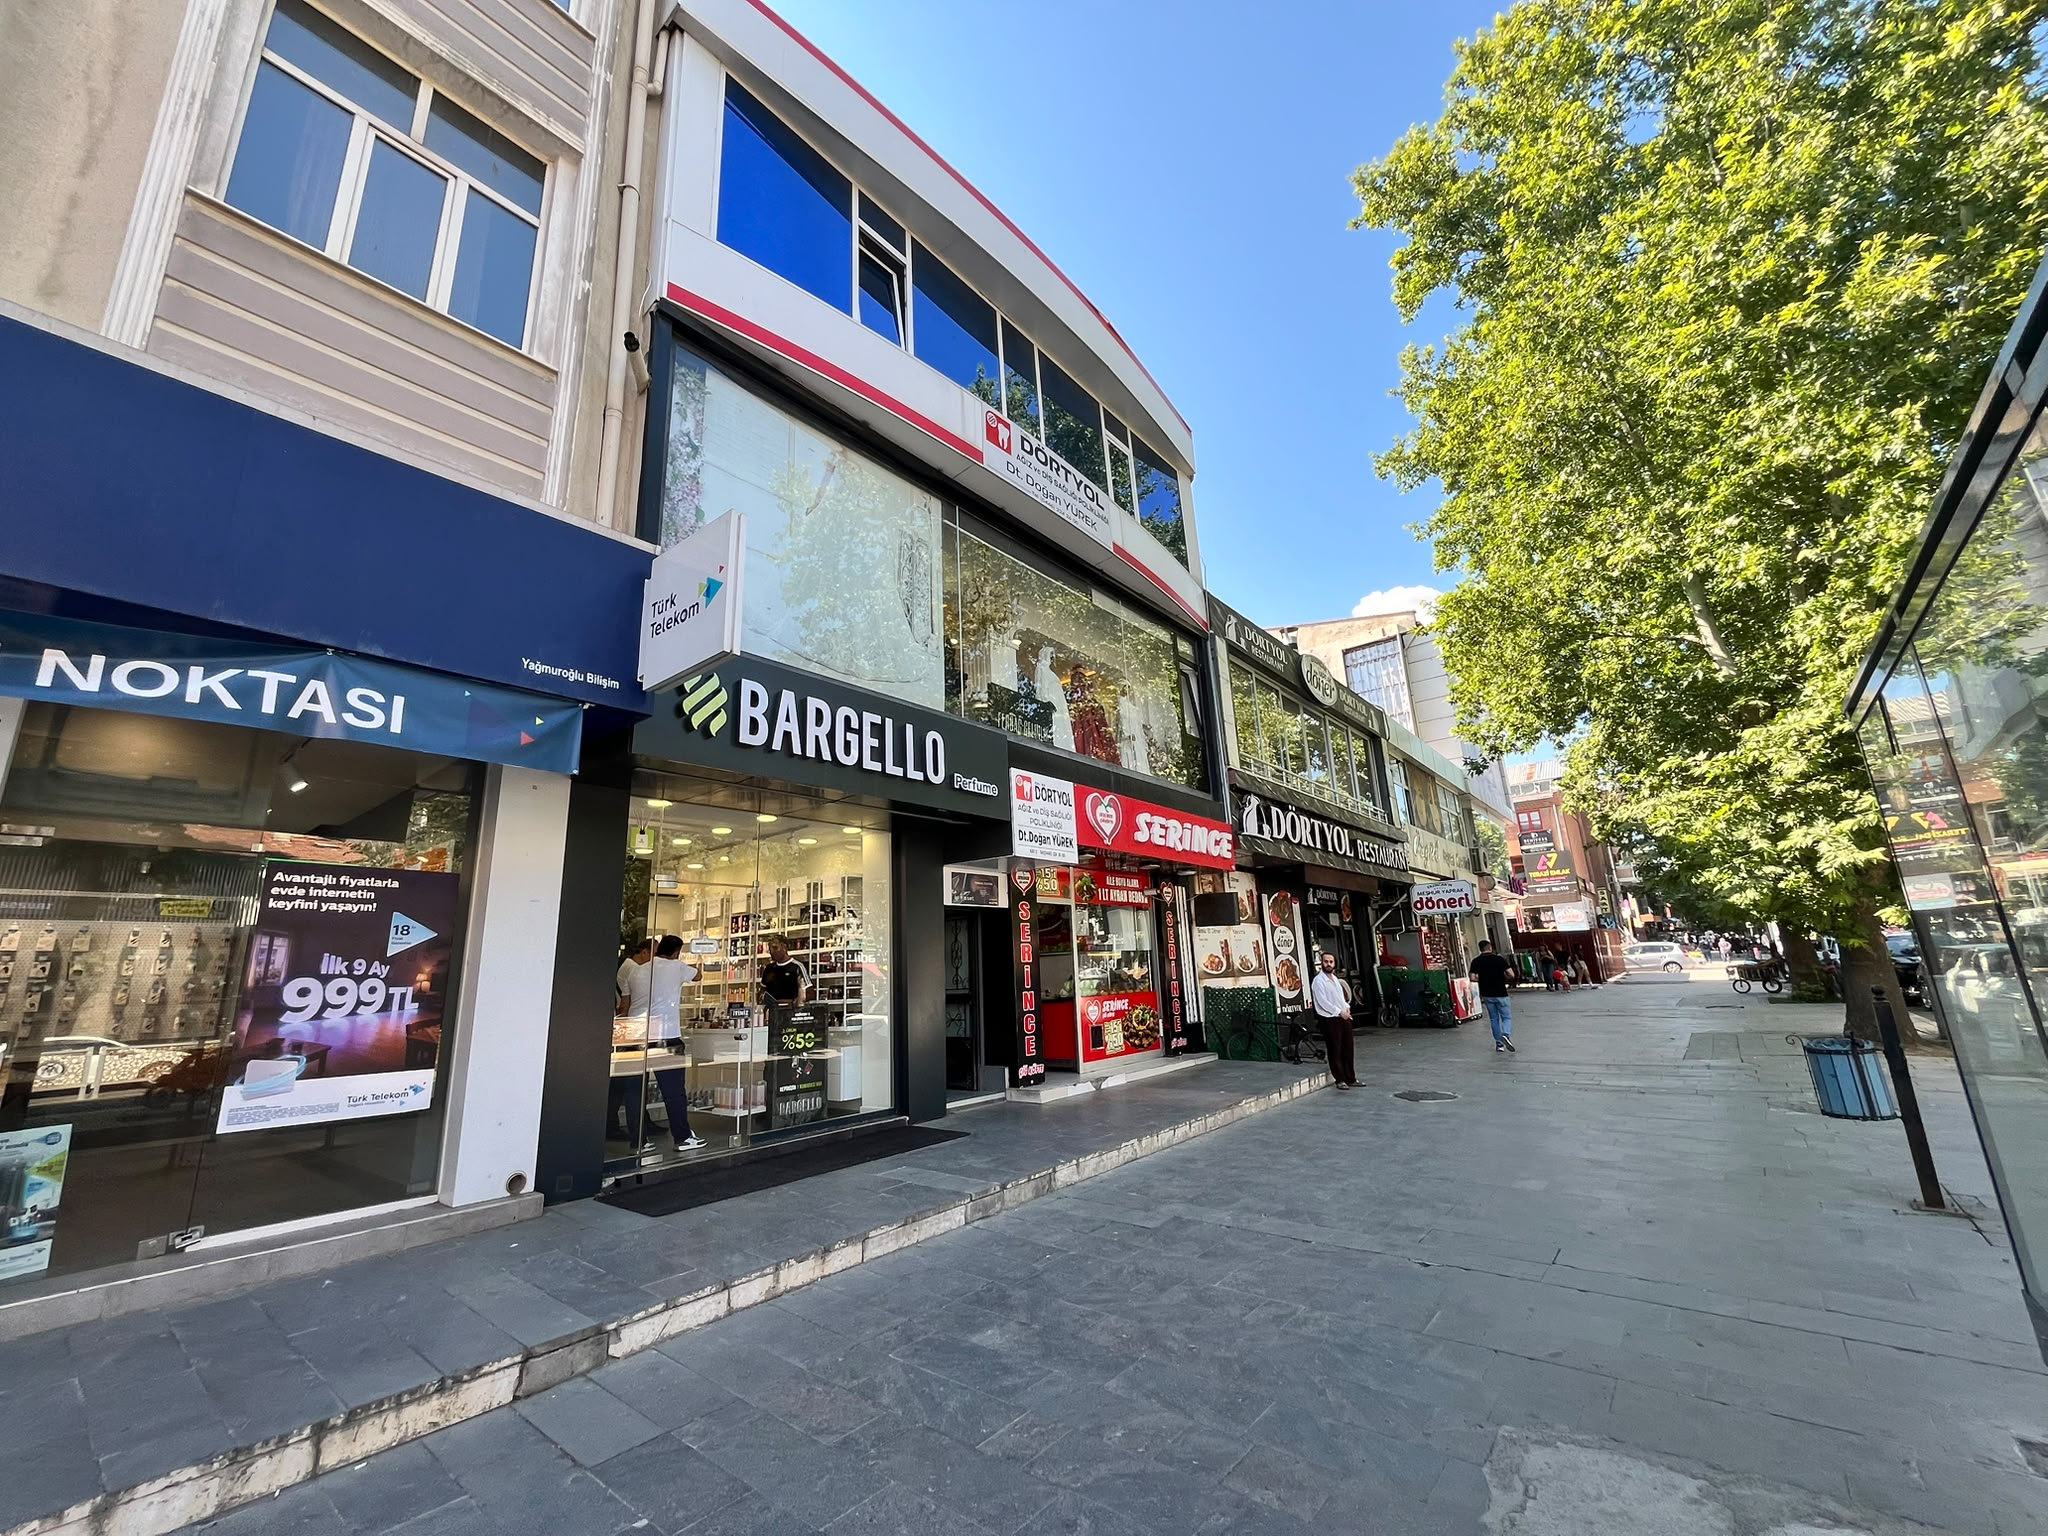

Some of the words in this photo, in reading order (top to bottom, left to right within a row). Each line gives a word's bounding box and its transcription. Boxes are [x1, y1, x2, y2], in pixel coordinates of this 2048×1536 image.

[1020, 435, 1105, 511] DÖRTYOL
[1006, 460, 1023, 480] Dt.
[1026, 473, 1061, 503] Doğan
[1063, 499, 1098, 532] YÜREK
[651, 592, 677, 618] Türk
[650, 601, 699, 638] Telekom
[1244, 625, 1288, 665] DÖRTYOL
[1250, 645, 1285, 673] RESTAURANT
[522, 658, 584, 682] Yağmuroğlu
[586, 672, 620, 689] Bilişim
[1305, 664, 1335, 699] döner
[35, 649, 404, 733] NOKTASI
[739, 678, 946, 784] BARGELLO
[954, 773, 998, 797] Perfume
[1035, 784, 1072, 807] DÖRTYOL
[1051, 834, 1074, 849] YÜREK
[1270, 804, 1354, 857] DÖRTYOL
[271, 885, 306, 896] evde
[308, 888, 375, 900] internetin
[273, 872, 337, 886] Avantajlı
[339, 875, 400, 889] fiyatlarla
[268, 898, 318, 911] keyfini
[320, 901, 377, 914] yaşayın!
[392, 925, 411, 937] 18
[352, 959, 367, 975] 9
[368, 960, 391, 978] Ay
[279, 977, 386, 1024] 999
[388, 986, 420, 1011] TL
[782, 1032, 815, 1049] %50
[347, 1095, 368, 1104] Türk
[371, 1091, 409, 1101] Telekom
[779, 1096, 822, 1116] BARGELLO
